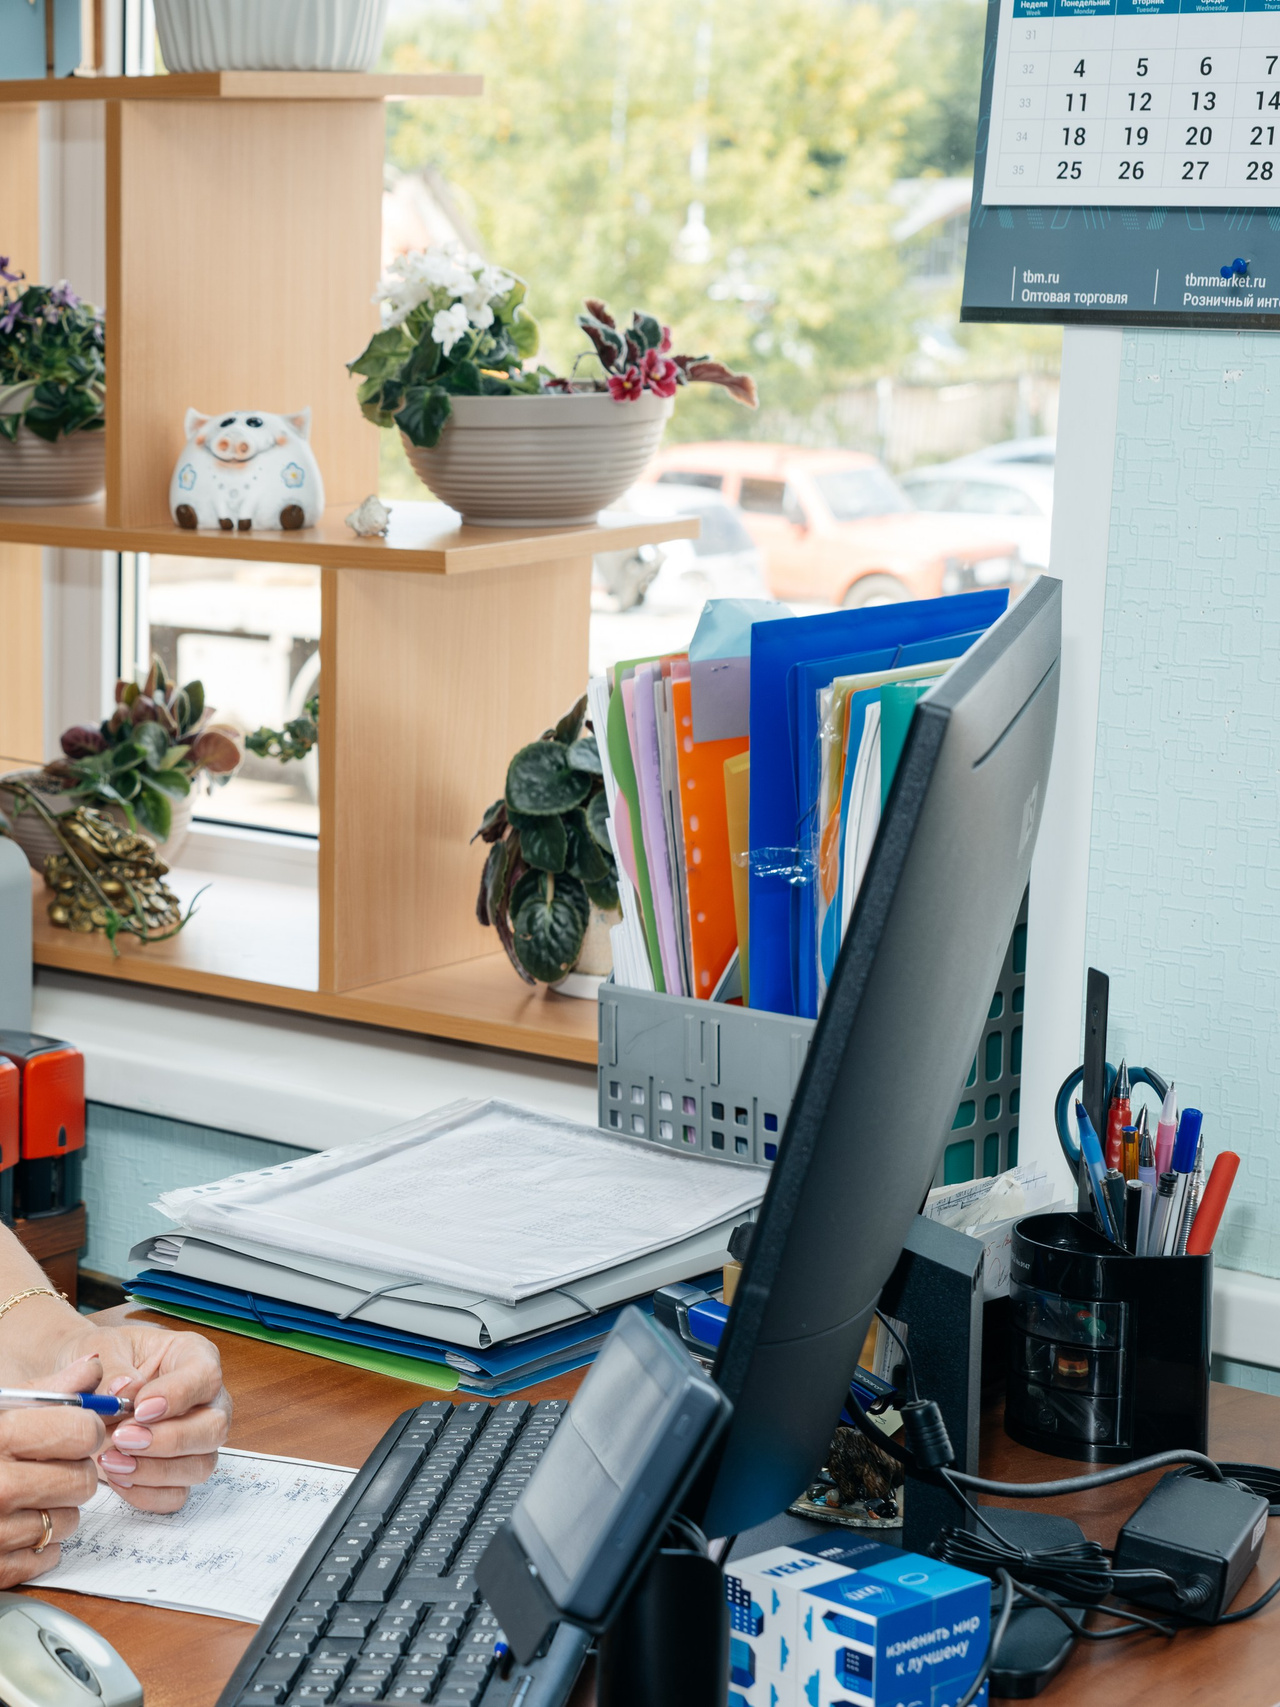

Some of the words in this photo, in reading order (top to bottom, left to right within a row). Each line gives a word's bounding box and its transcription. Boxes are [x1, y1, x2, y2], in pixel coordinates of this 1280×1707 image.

[1025, 30, 1037, 40] 31
[1023, 64, 1034, 74] 32
[1074, 59, 1085, 77] 4
[1137, 58, 1148, 76] 5
[1200, 57, 1212, 75] 6
[1266, 56, 1278, 74] 7
[1019, 98, 1031, 108] 33
[1066, 93, 1086, 111] 11
[1128, 92, 1151, 111] 12
[1192, 92, 1216, 110] 13
[1257, 91, 1280, 110] 14
[1016, 132, 1028, 142] 34
[1063, 127, 1085, 145] 18
[1125, 127, 1148, 145] 19
[1186, 127, 1212, 145] 20
[1250, 126, 1274, 145] 21
[1013, 166, 1024, 175] 35
[1057, 161, 1082, 179] 25
[1118, 161, 1144, 179] 26
[1182, 161, 1209, 180] 27
[1246, 161, 1273, 180] 28
[1023, 269, 1060, 284] tbm.ru
[1185, 272, 1266, 288] tbmmarket.ru
[1021, 289, 1071, 303] Оптовая
[1074, 292, 1128, 307] торговля
[1183, 292, 1254, 308] Розничный
[761, 1557, 822, 1578] VEKA
[886, 1627, 950, 1658] изменить
[952, 1616, 980, 1636] мир
[895, 1661, 905, 1676] к
[907, 1640, 970, 1674] лучшему
